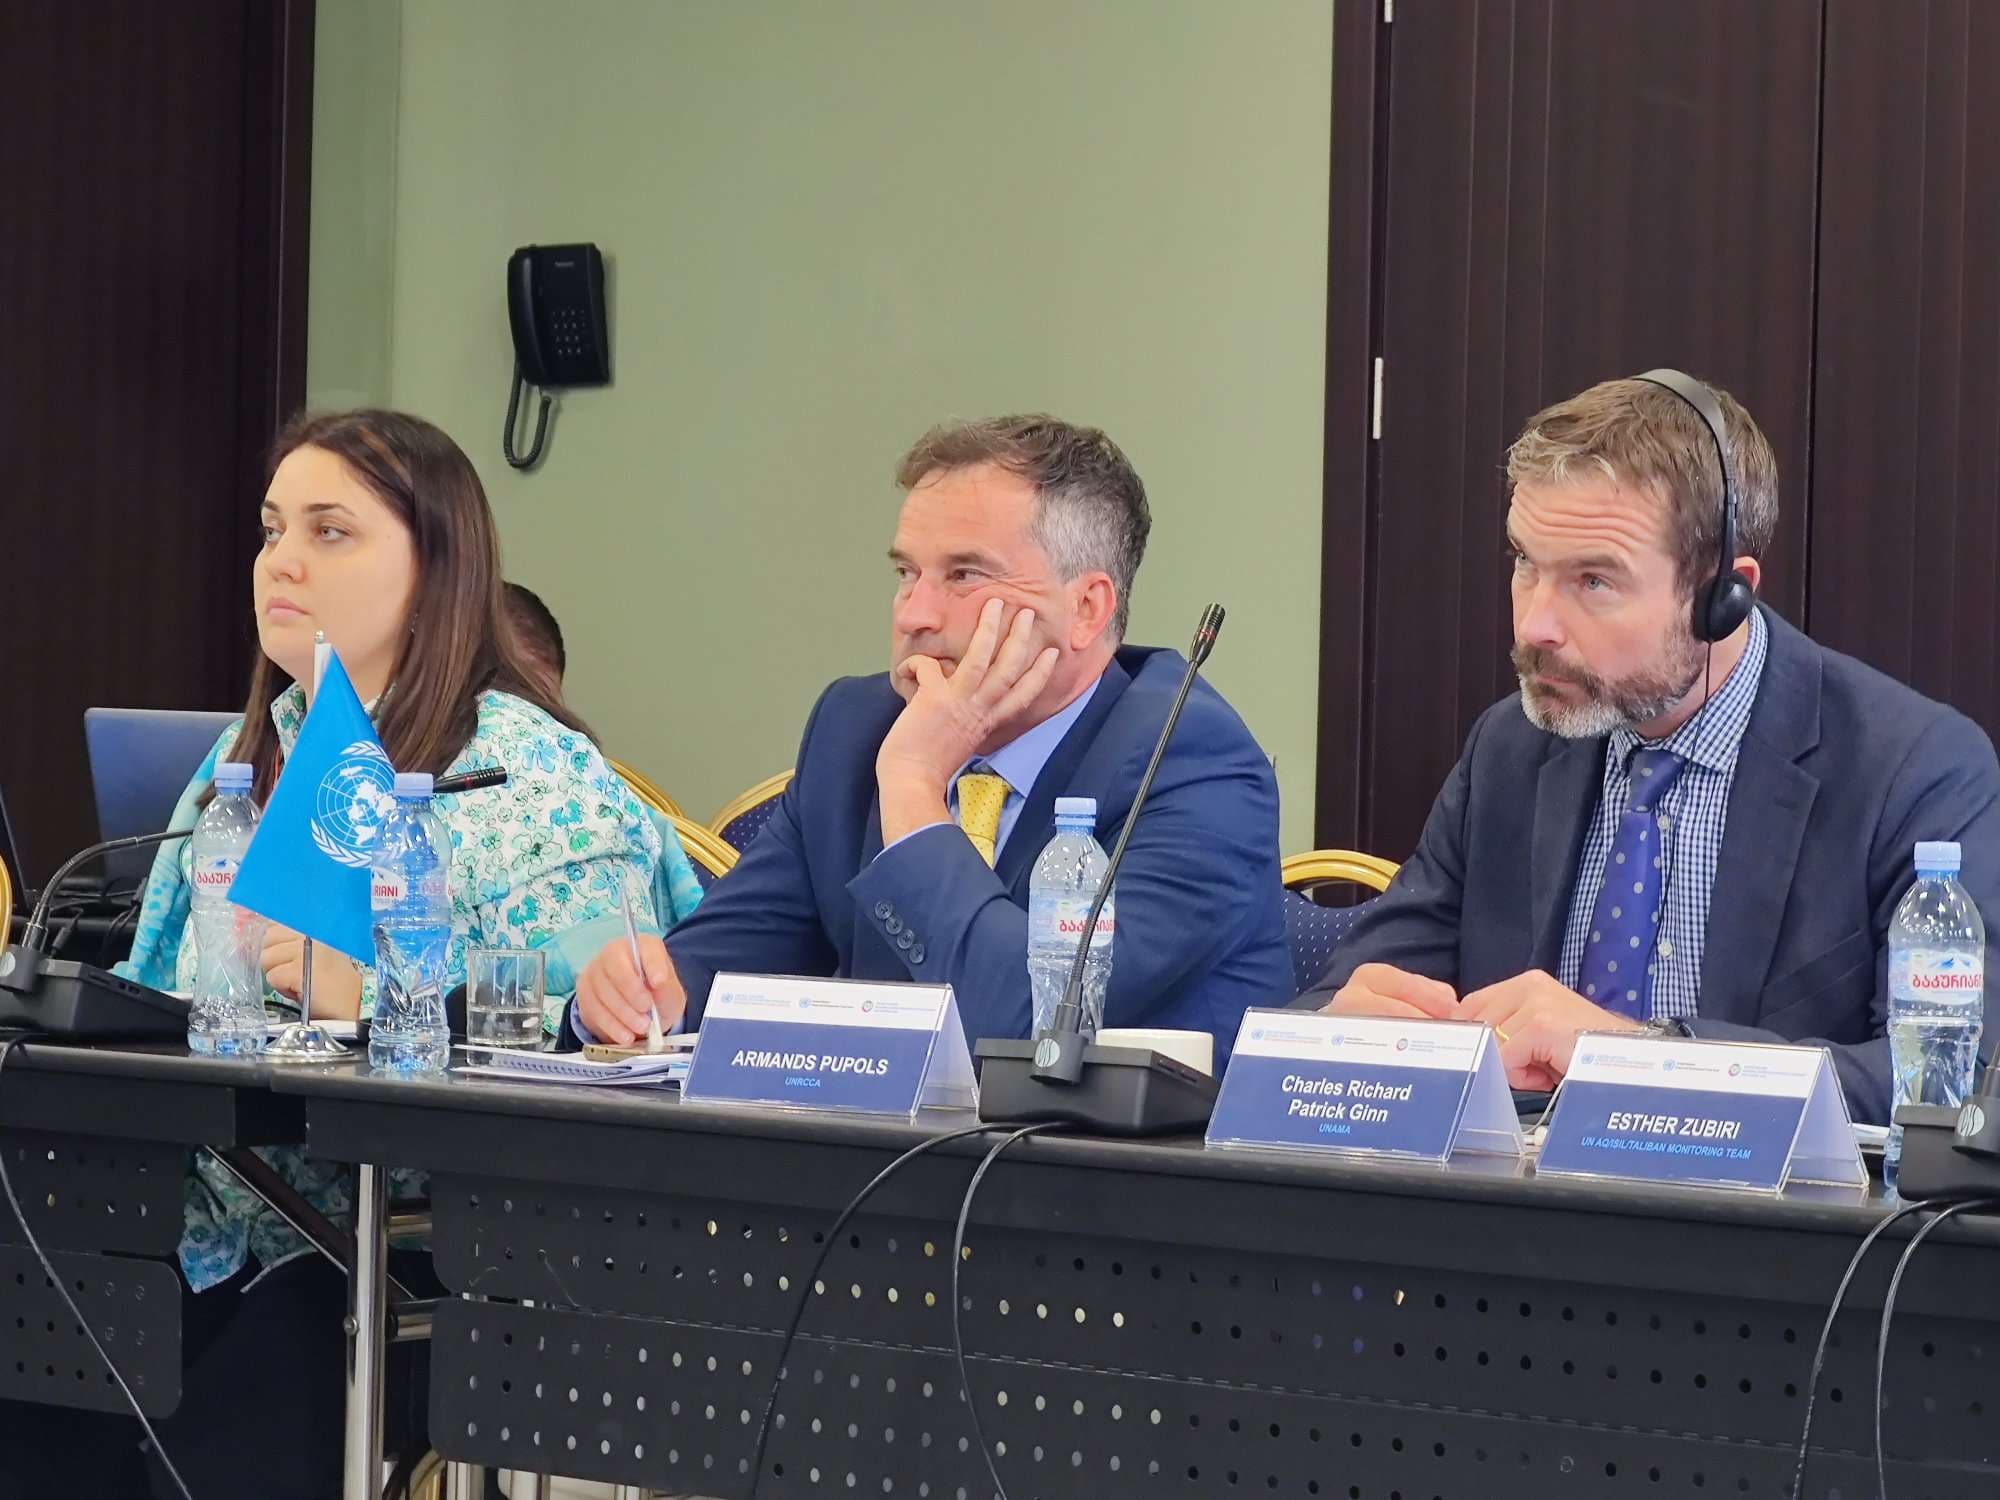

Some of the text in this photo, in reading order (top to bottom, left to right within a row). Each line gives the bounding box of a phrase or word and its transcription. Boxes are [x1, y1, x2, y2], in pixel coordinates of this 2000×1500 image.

[731, 1050, 889, 1075] ARMANDS PUPOLS
[785, 1077, 821, 1087] UNRCCA
[1281, 1075, 1413, 1101] Charles Richard
[1288, 1099, 1388, 1122] Patrick Ginn
[1319, 1123, 1351, 1134] UNAMA
[1607, 1111, 1741, 1139] ESTHER ZUBIRI
[1581, 1137, 1751, 1159] UN AQ/ISIL/TALIBAN MONITORING TEAM
